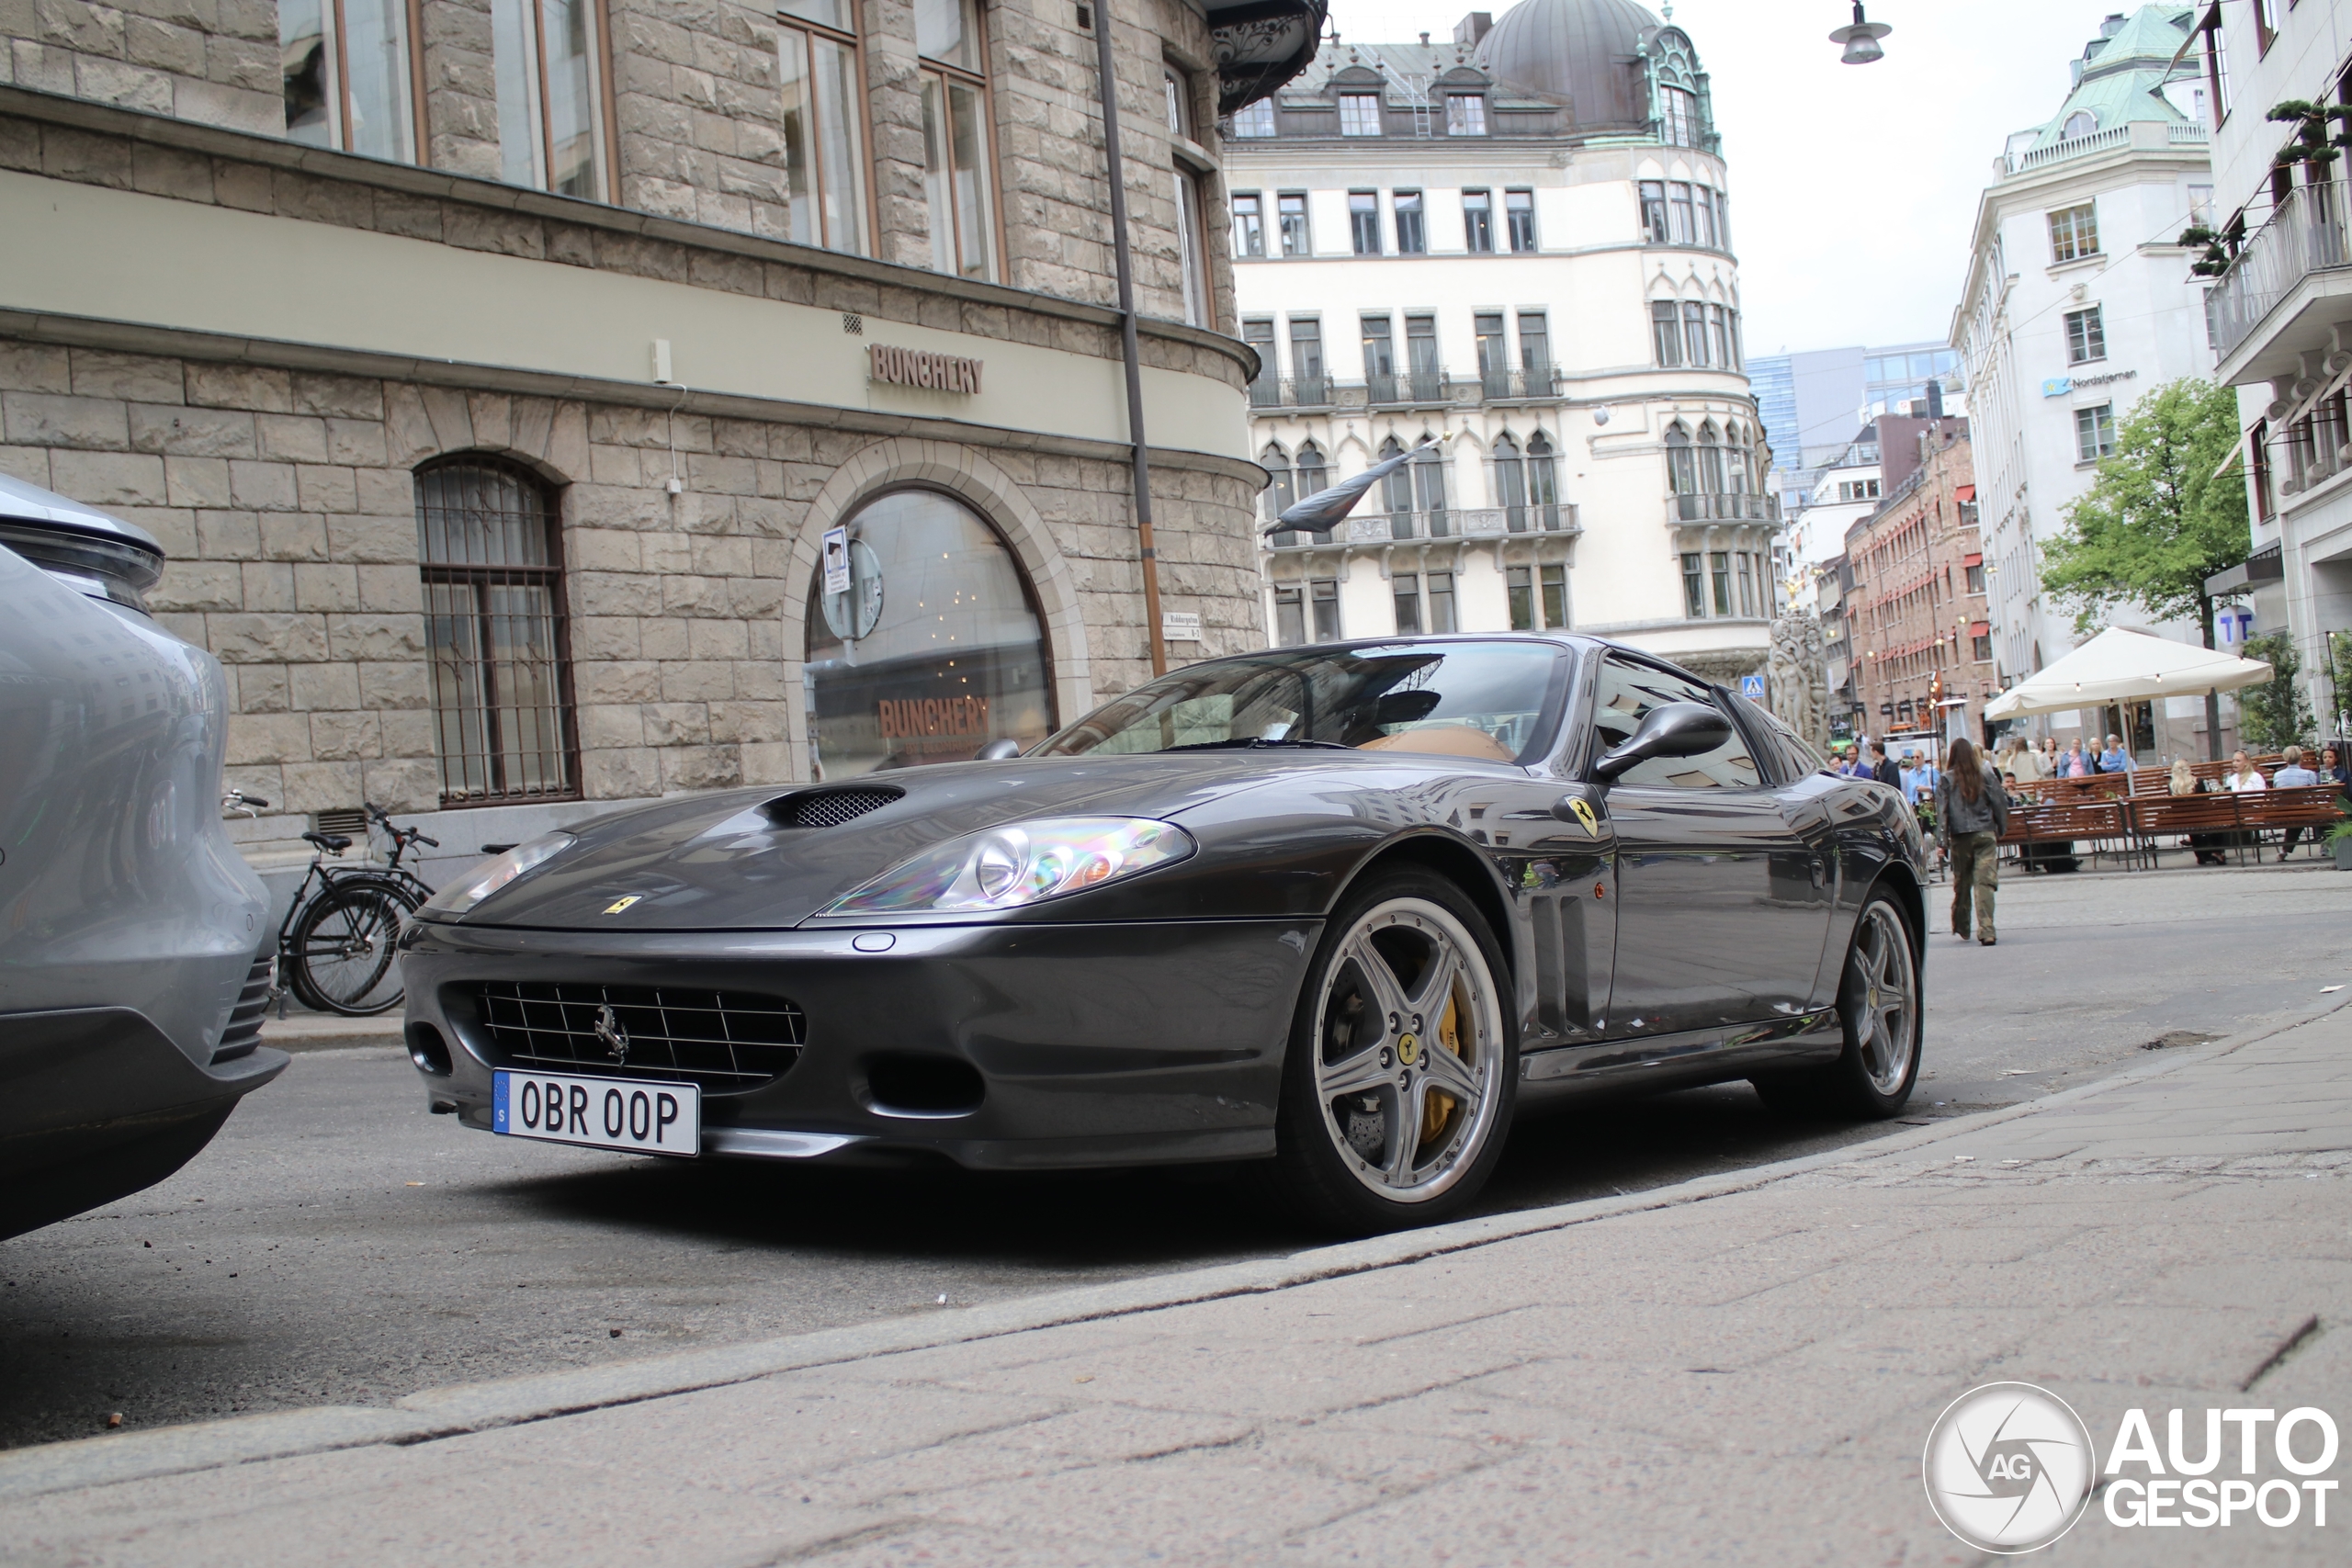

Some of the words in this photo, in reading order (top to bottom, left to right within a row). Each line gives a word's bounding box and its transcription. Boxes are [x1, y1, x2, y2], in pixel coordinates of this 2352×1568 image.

[870, 343, 983, 394] BUNCHERY
[2073, 370, 2137, 387] Nordstjernan
[2221, 616, 2233, 642] T
[2238, 615, 2252, 640] T
[879, 697, 990, 738] BUNCHERY
[498, 1109, 505, 1122] S
[521, 1080, 589, 1135] OBR
